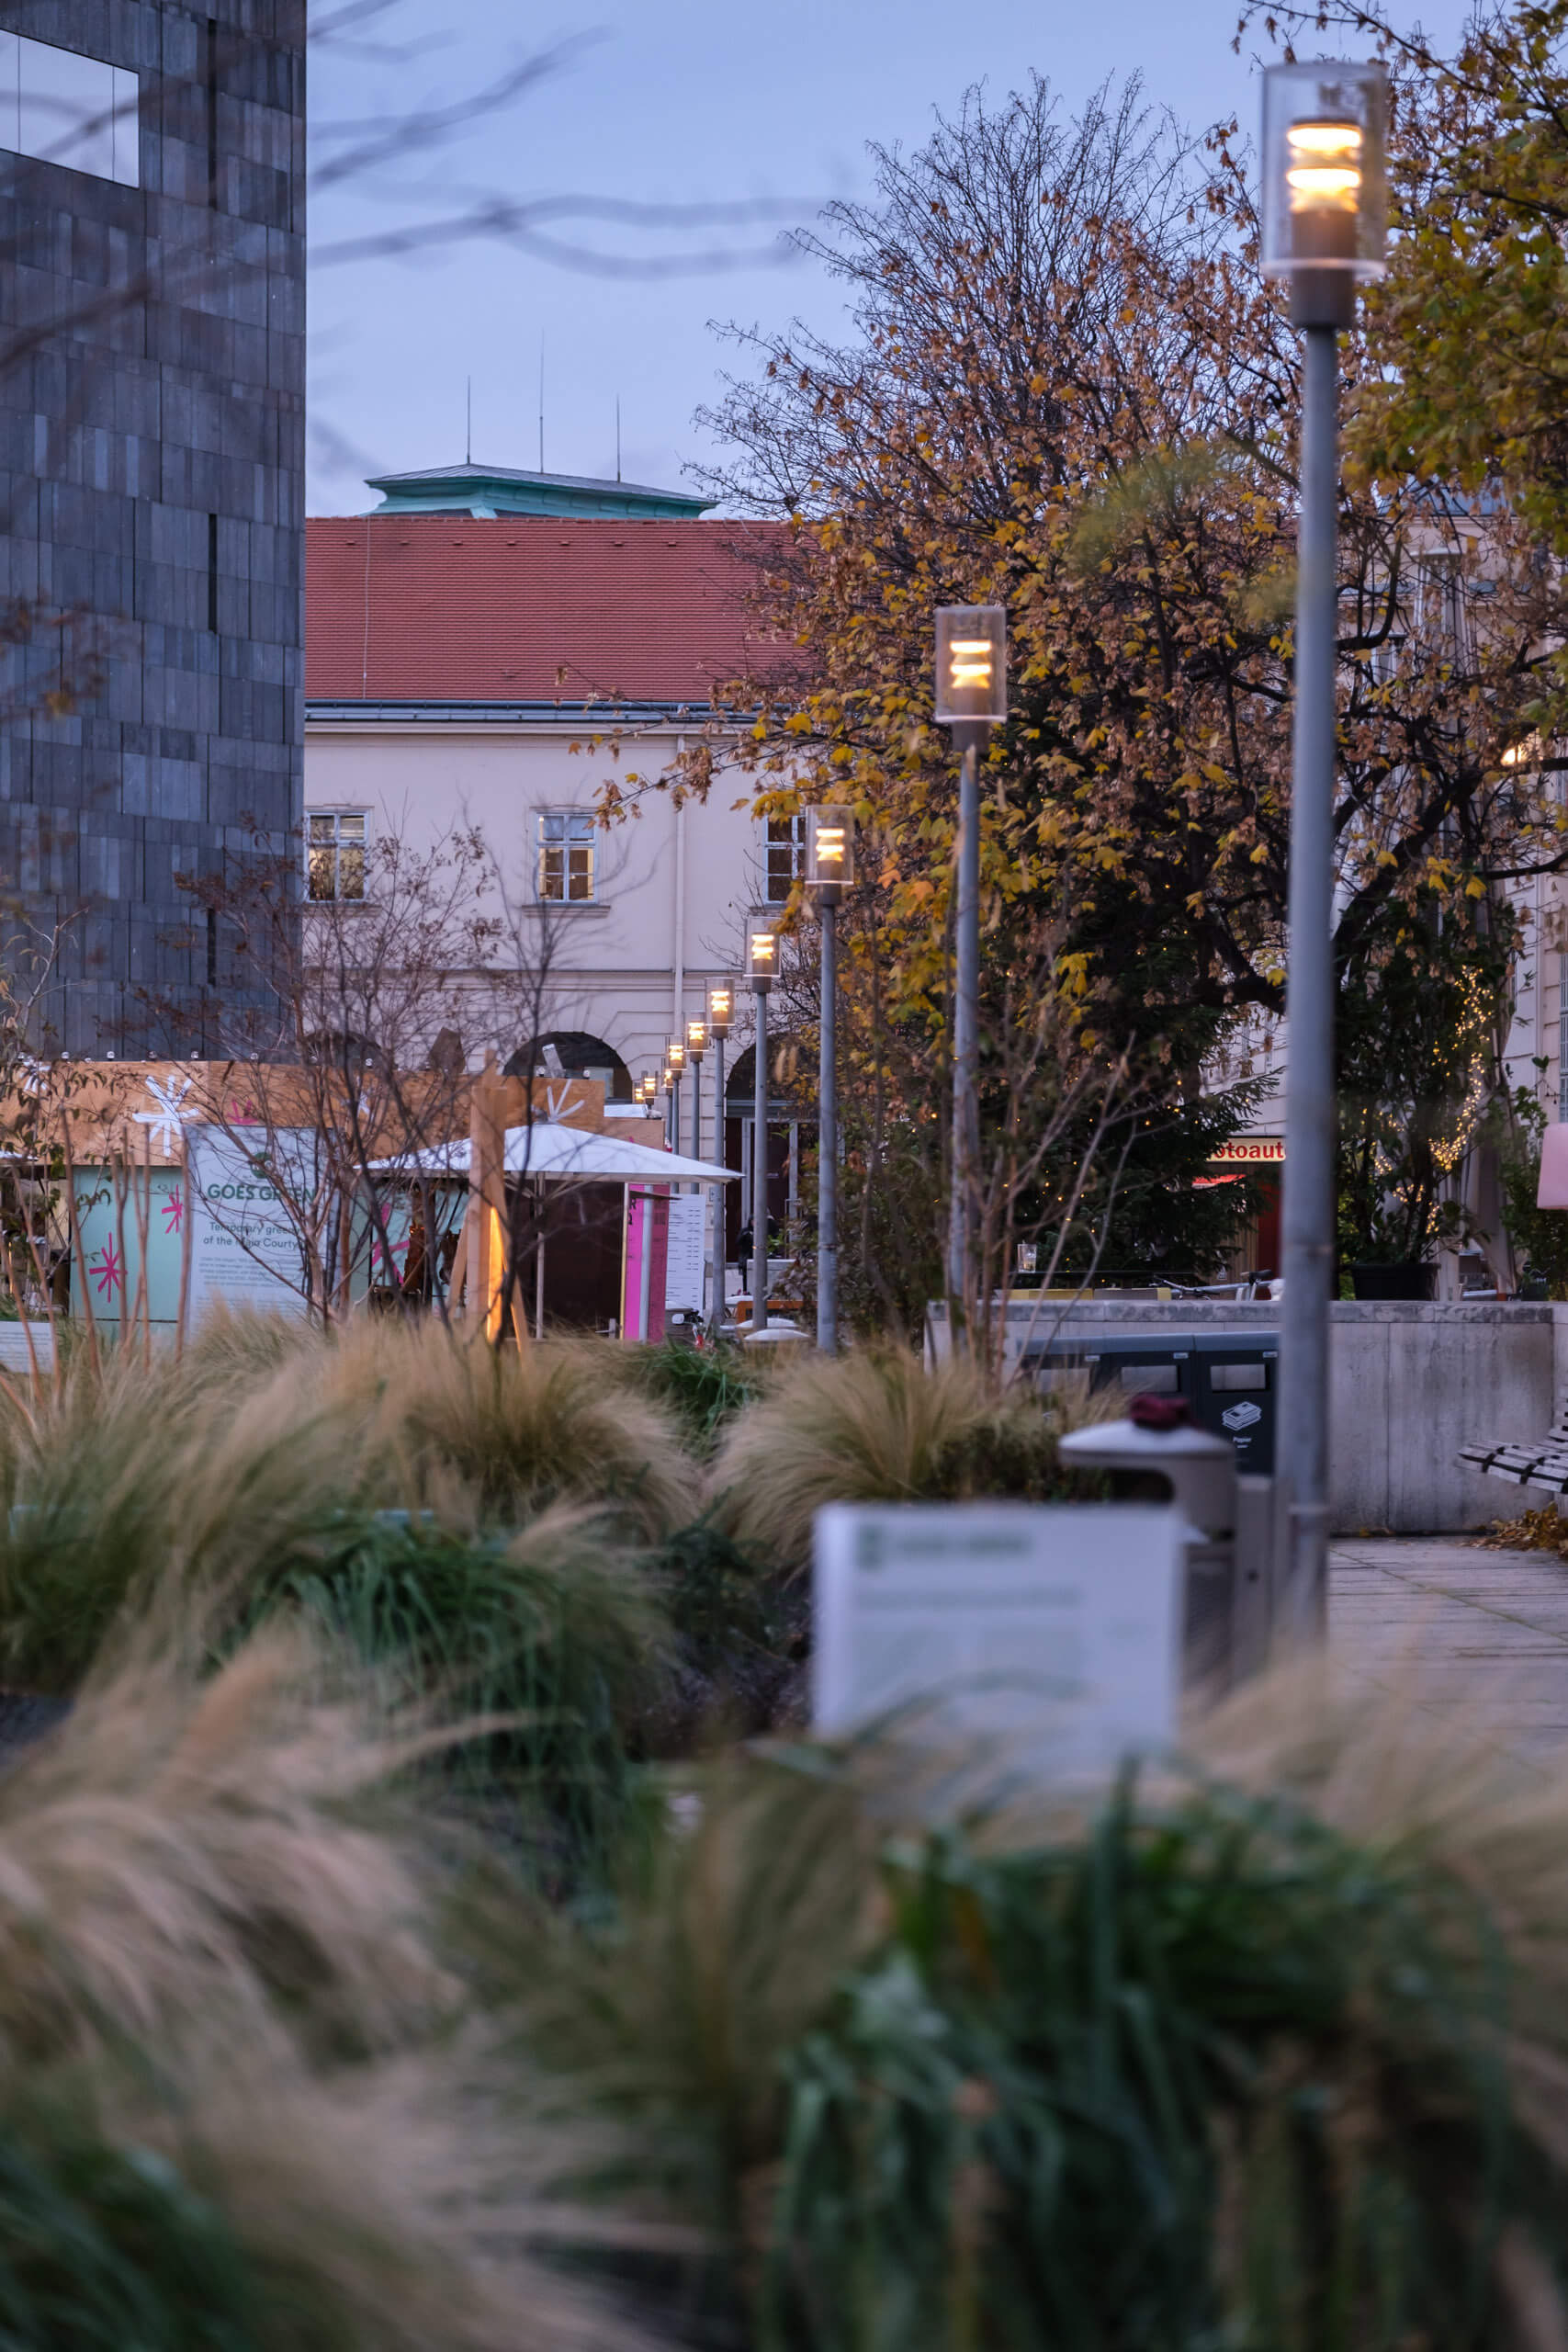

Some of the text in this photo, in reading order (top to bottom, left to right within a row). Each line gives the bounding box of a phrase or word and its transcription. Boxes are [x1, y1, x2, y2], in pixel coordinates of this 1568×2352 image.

[1213, 1142, 1284, 1159] otoaut
[208, 1183, 254, 1200] GOES
[203, 1236, 214, 1245] of
[216, 1236, 232, 1246] the
